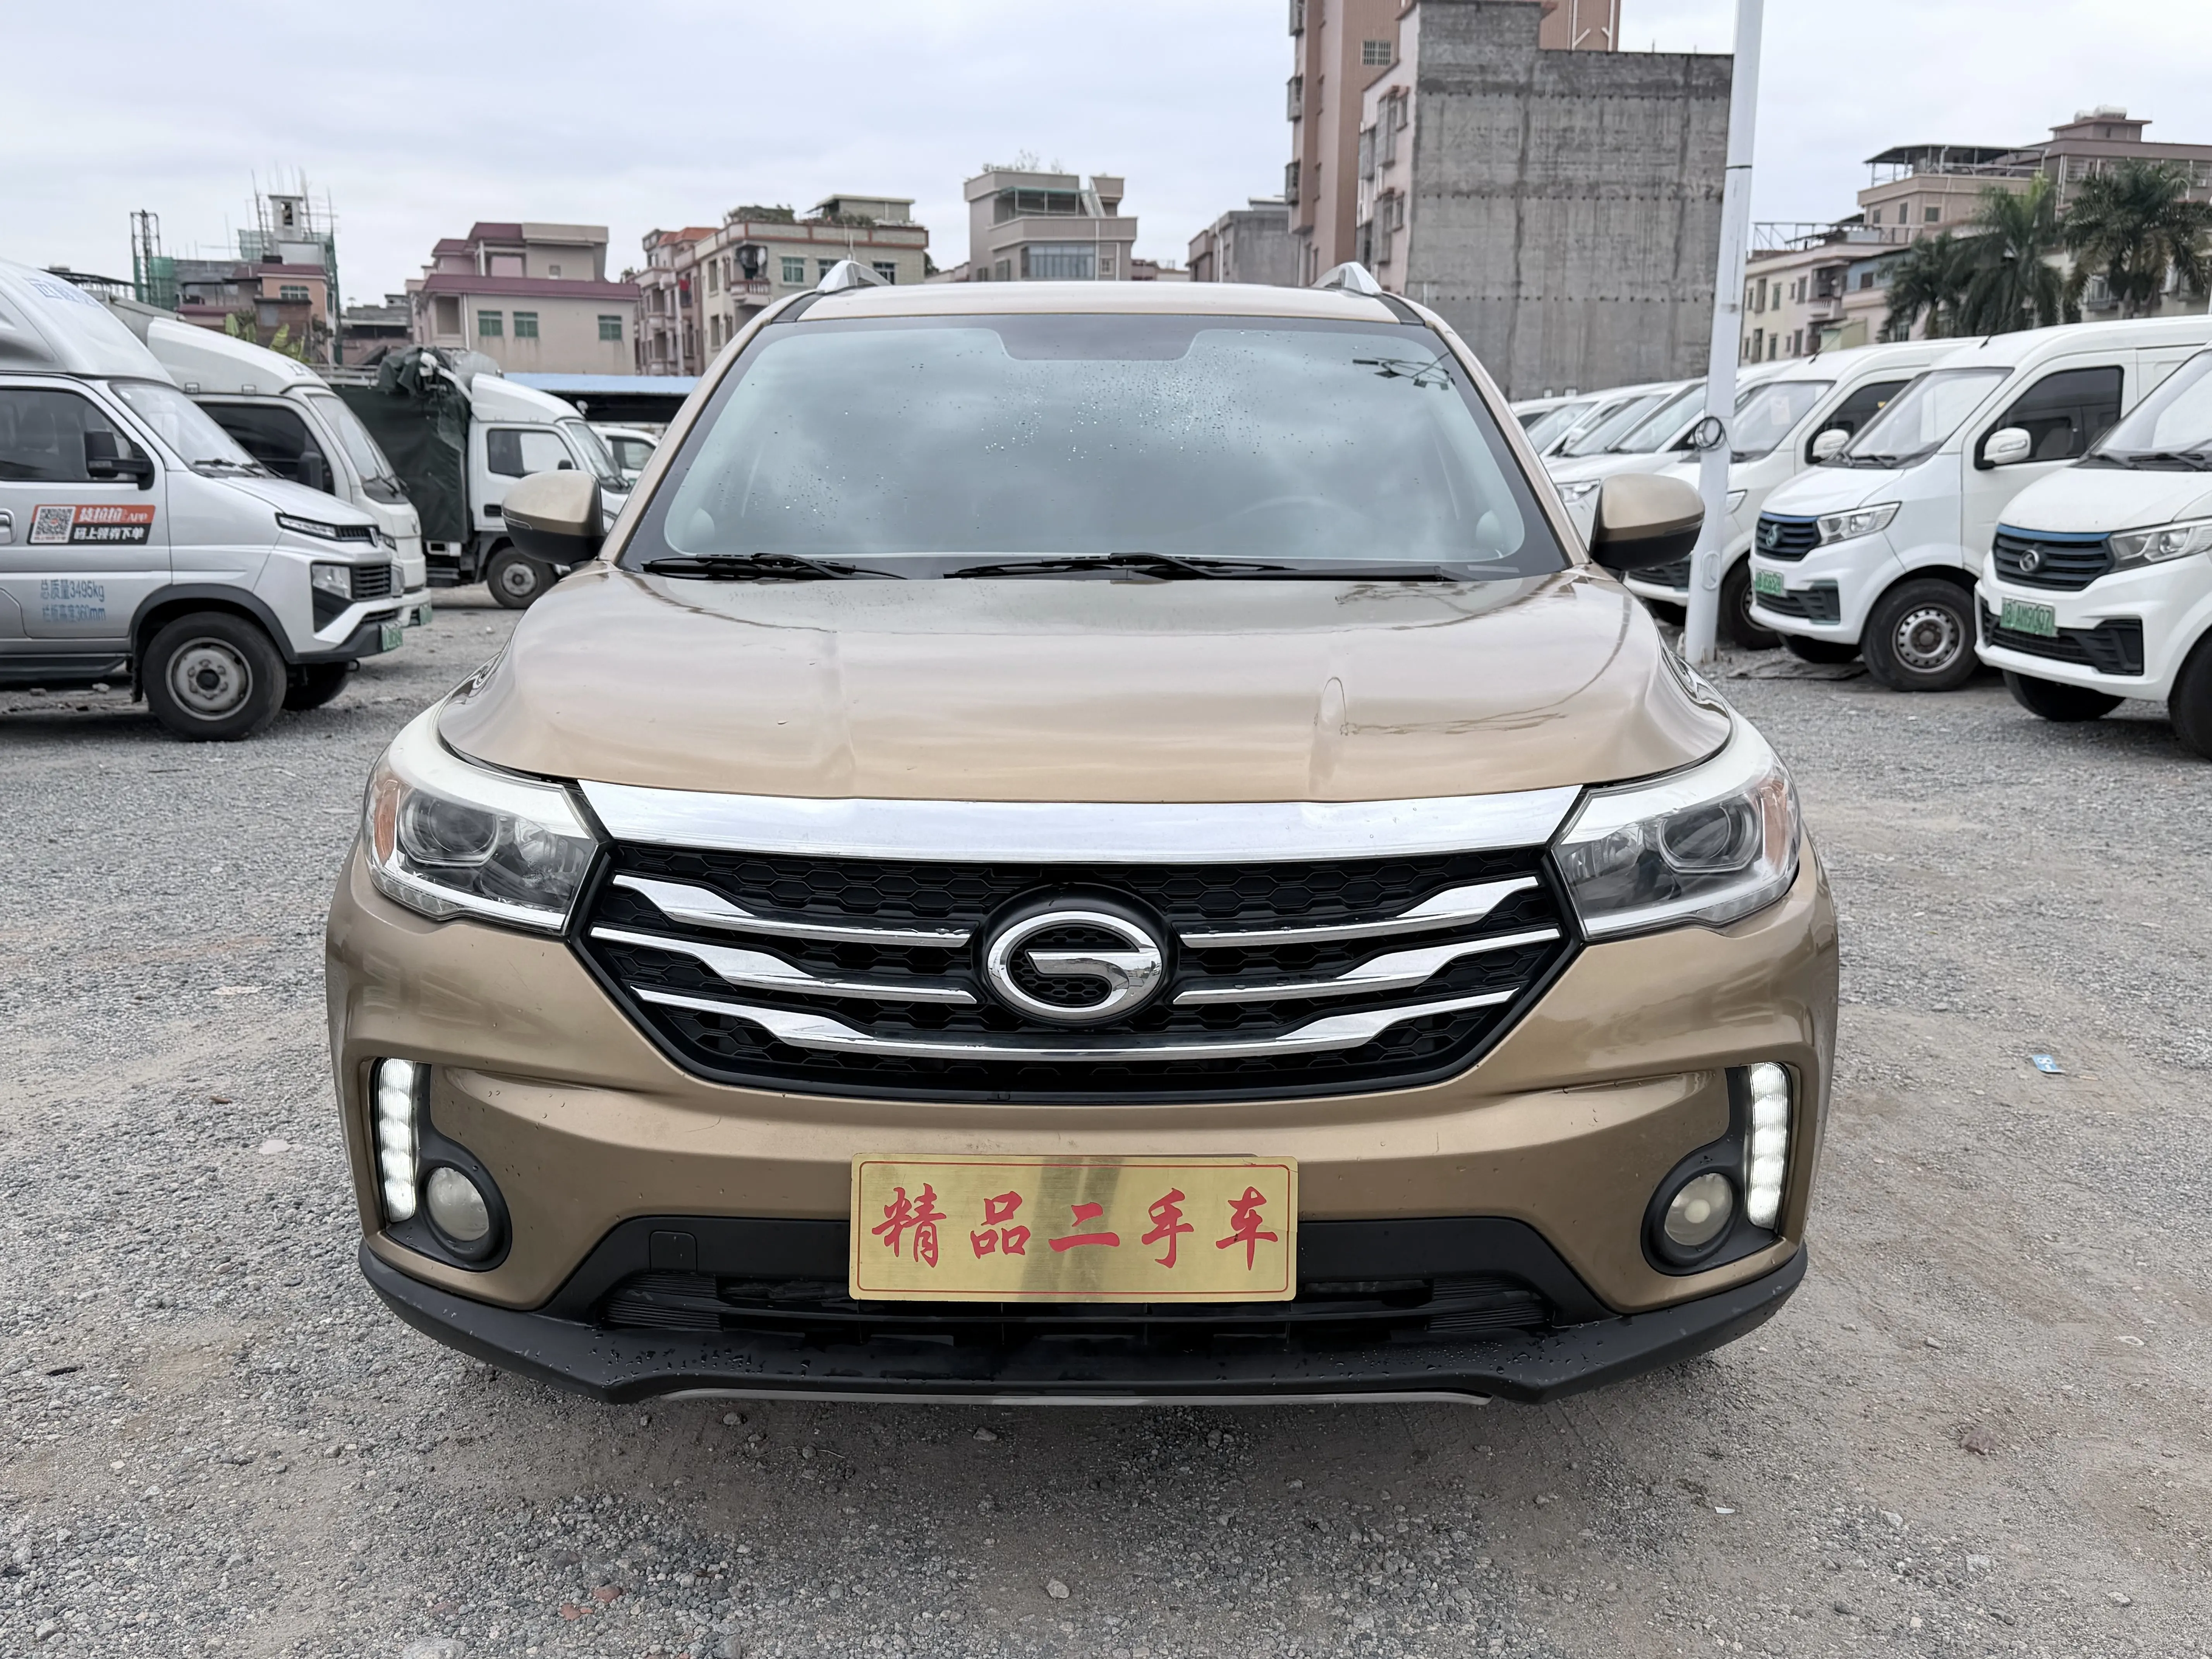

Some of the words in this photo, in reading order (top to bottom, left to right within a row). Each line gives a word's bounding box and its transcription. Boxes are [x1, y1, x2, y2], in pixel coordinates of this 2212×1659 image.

[40, 579, 105, 603] 总质量3495kg
[871, 1182, 1278, 1271] 精品二手车
